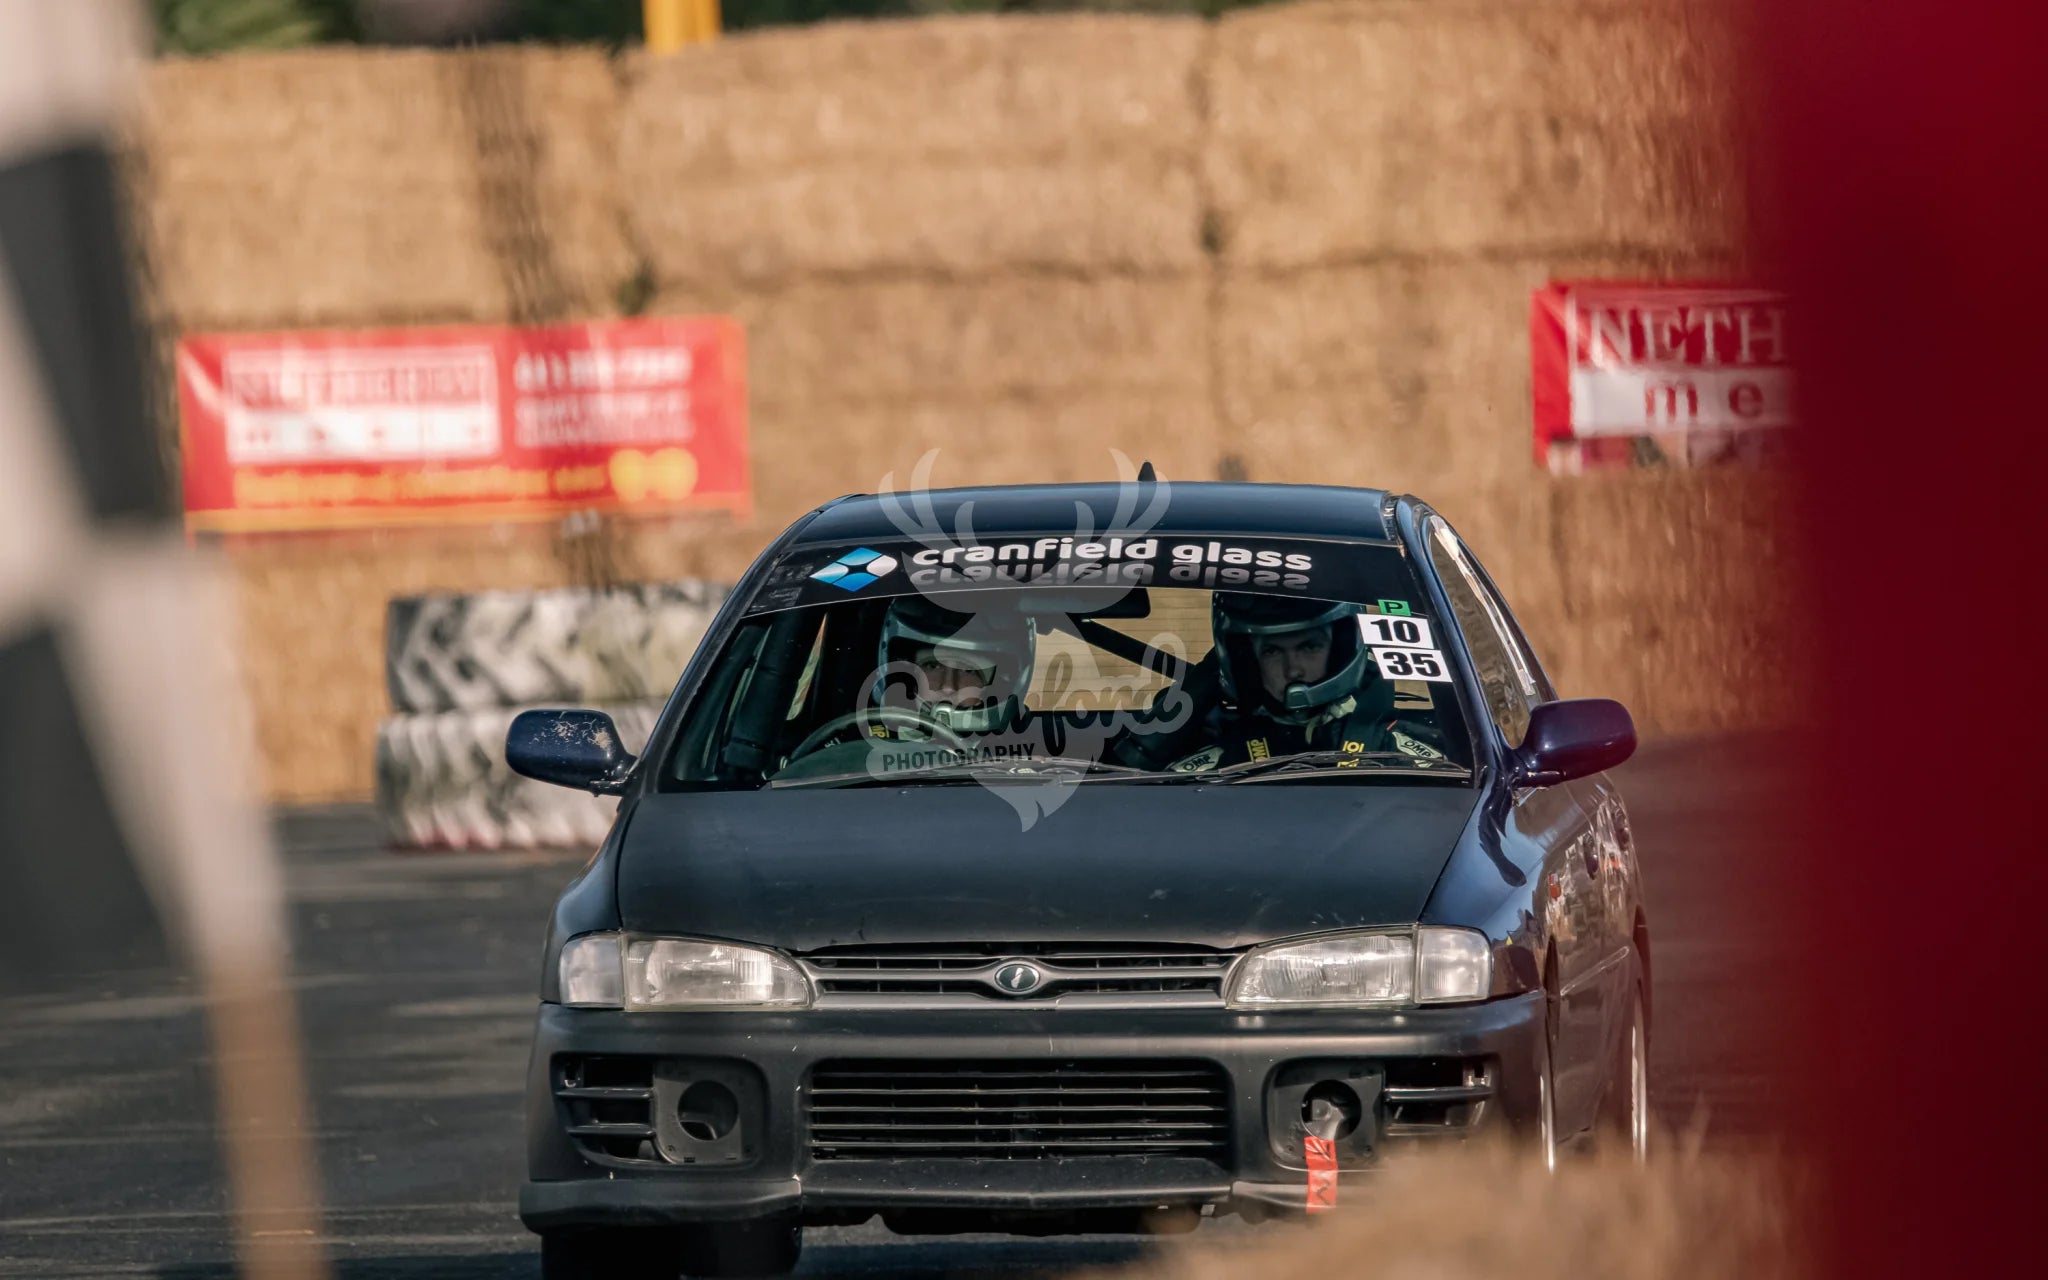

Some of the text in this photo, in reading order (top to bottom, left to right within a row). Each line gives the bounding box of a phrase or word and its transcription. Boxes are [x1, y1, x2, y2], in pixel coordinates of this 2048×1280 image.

[912, 537, 1312, 571] cranfield glass
[1384, 601, 1403, 614] P
[1370, 619, 1421, 644] 10
[1383, 651, 1442, 678] 35
[1403, 740, 1433, 758] OMP
[1183, 753, 1212, 772] OMP
